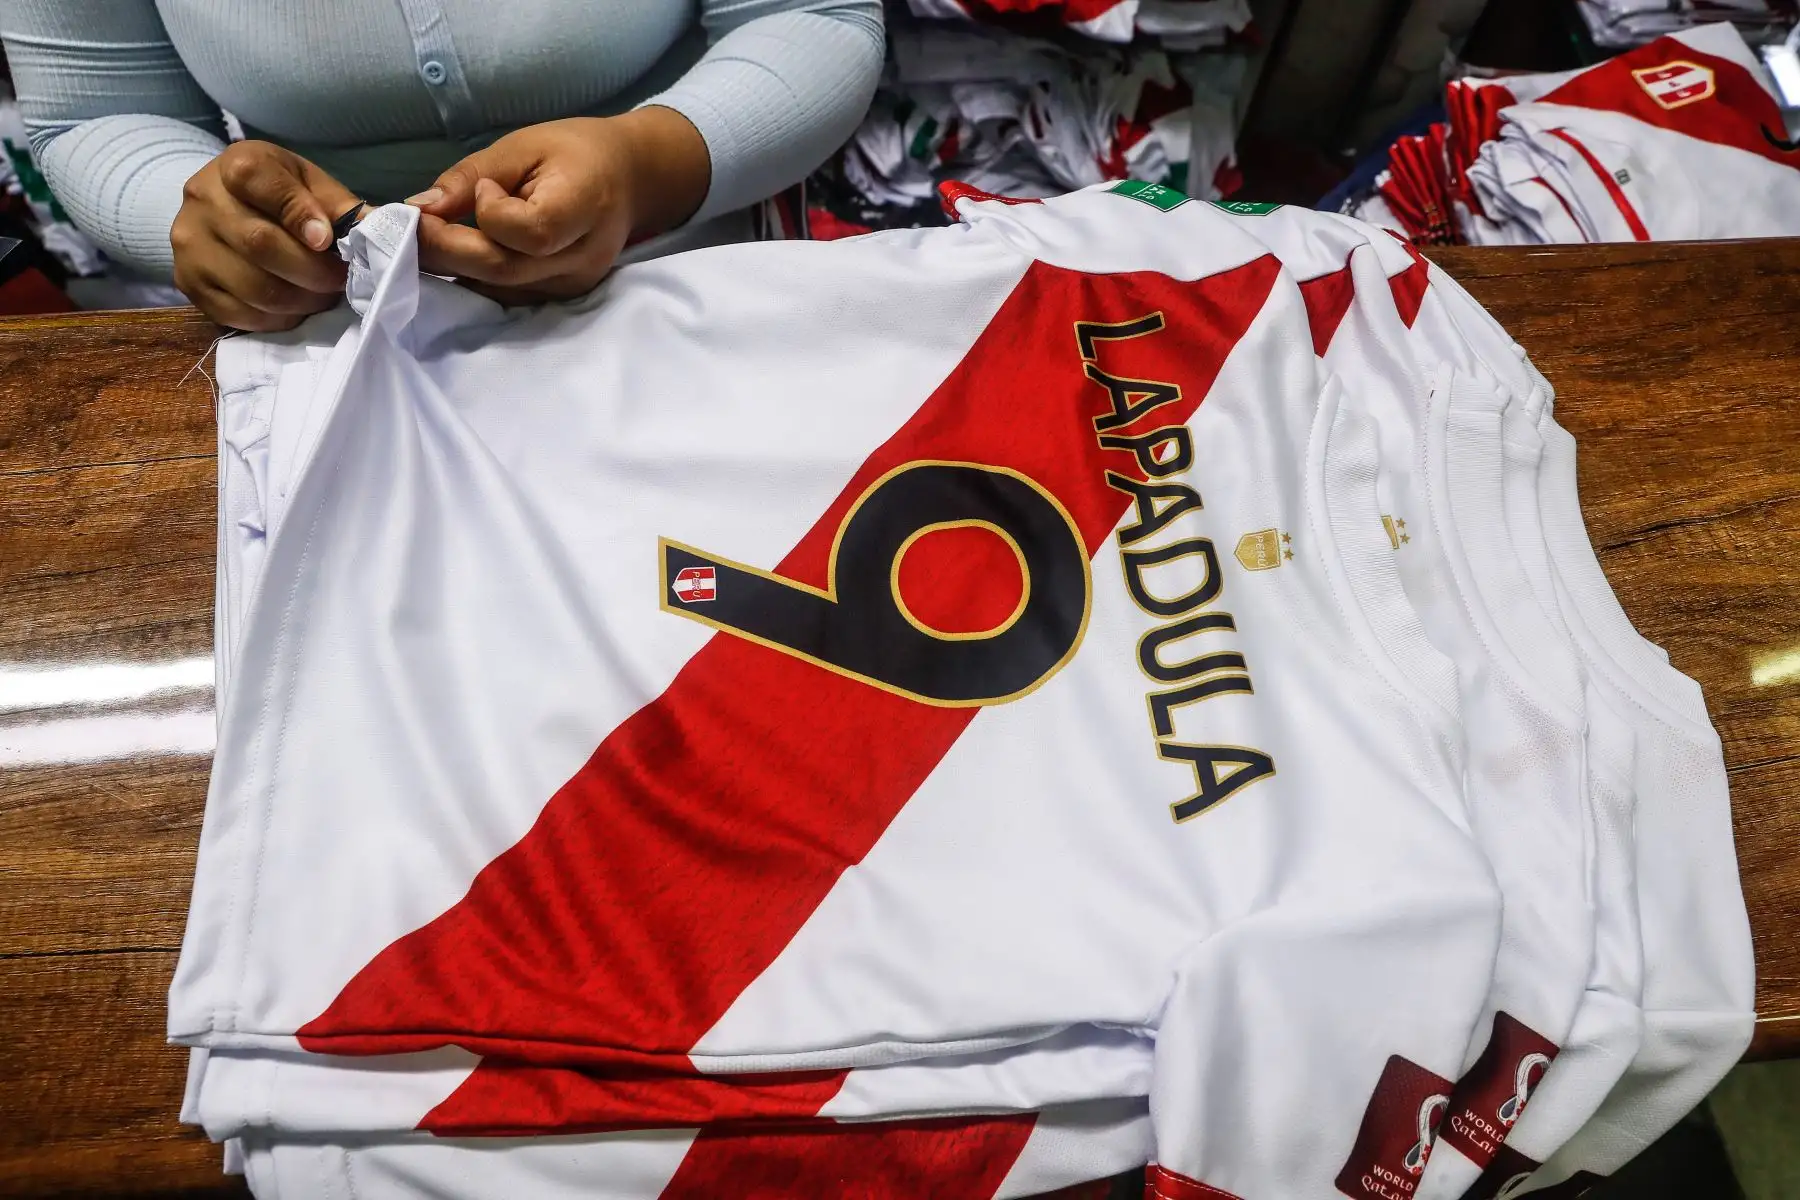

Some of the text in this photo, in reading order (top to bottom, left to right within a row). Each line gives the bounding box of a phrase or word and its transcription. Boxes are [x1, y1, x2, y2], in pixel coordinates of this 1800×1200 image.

[658, 460, 1093, 708] 9
[1074, 311, 1276, 824] LAPADULA
[1373, 1164, 1413, 1192] WORLD
[1465, 1109, 1504, 1143] WORLD
